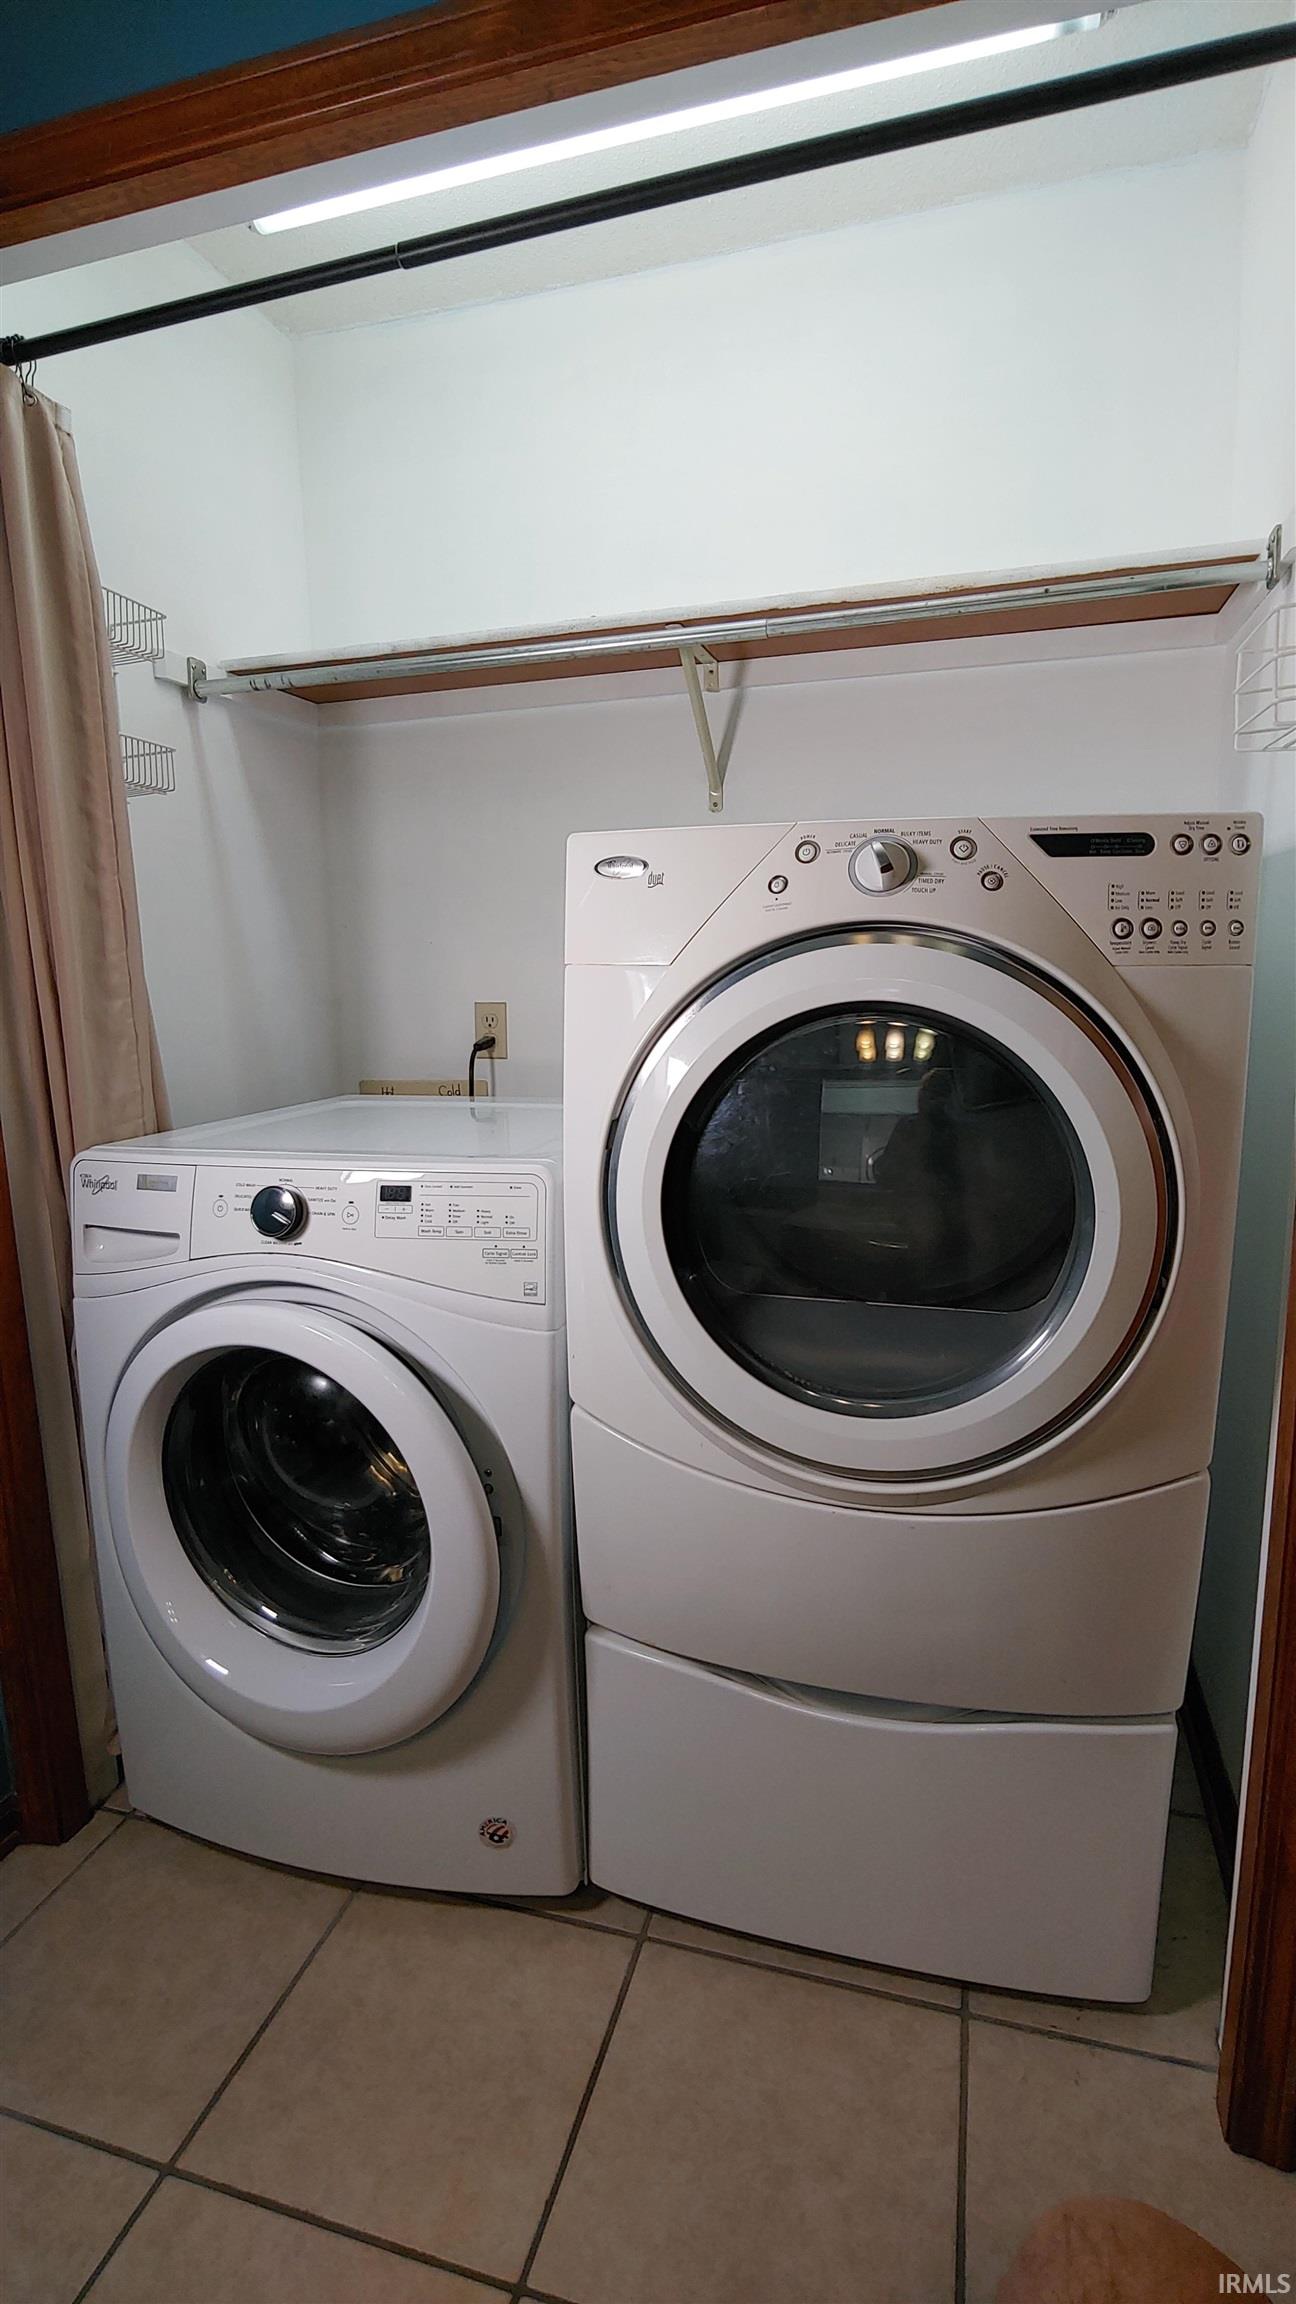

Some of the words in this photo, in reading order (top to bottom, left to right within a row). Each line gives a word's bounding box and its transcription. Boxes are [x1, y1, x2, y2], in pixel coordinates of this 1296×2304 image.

[647, 871, 665, 889] duet
[439, 1083, 461, 1096] Cold
[81, 1175, 117, 1195] Whirlpool
